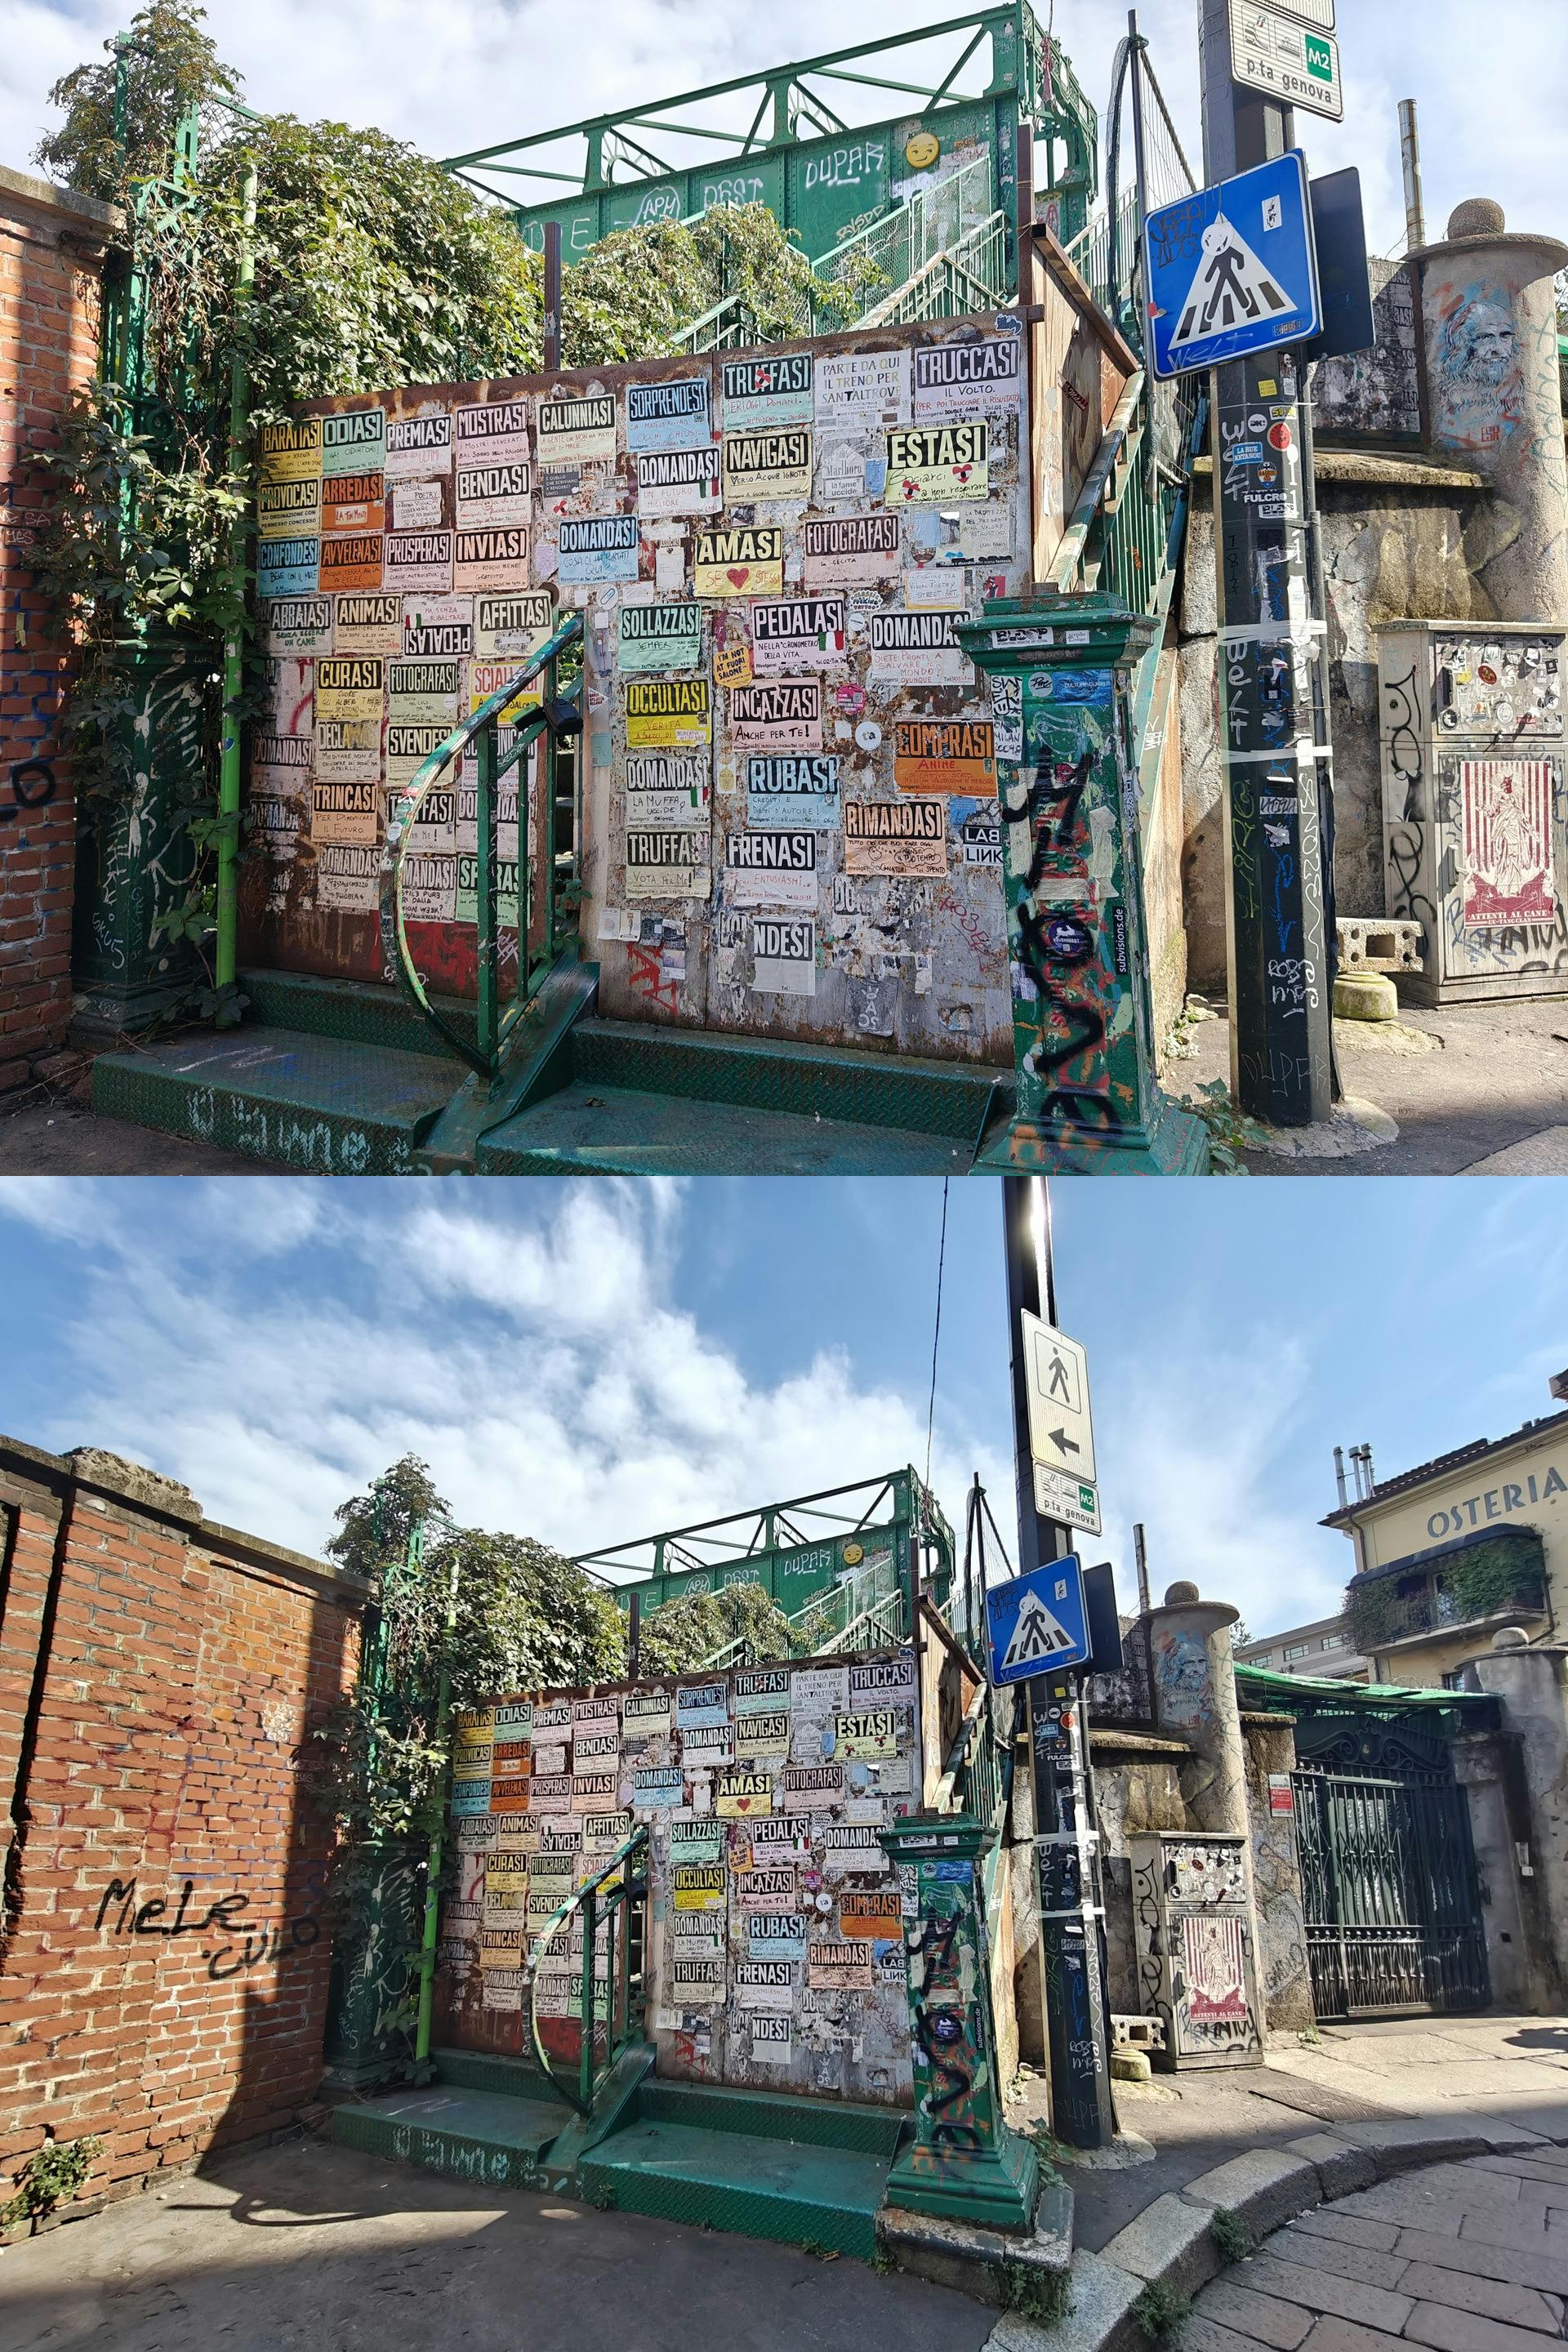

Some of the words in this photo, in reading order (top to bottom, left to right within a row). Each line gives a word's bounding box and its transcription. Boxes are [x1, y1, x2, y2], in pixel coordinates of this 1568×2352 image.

[1308, 47, 1330, 71] M2
[1246, 57, 1274, 81] p.ta
[1281, 74, 1332, 104] genova
[823, 362, 858, 376] PARTE
[861, 360, 877, 372] DA
[879, 357, 900, 369] QUI
[917, 341, 1018, 385] TRUCCASI
[824, 379, 834, 390] IL
[835, 374, 874, 388] TRENO
[877, 372, 900, 384] PER
[945, 388, 953, 398] IL
[960, 385, 996, 396] VOLTO.
[630, 384, 705, 420] SORPRENDESI
[949, 397, 981, 408] TRUCCARE
[457, 404, 527, 438] MOSTRASI
[541, 400, 612, 432] CALUNNIASI
[324, 413, 381, 446] ODIASI
[386, 419, 450, 450] PREMIASI
[492, 435, 523, 446] GENERATI
[547, 435, 565, 443] GENTE
[575, 433, 587, 442] NON
[505, 447, 528, 456] RAGIONE
[728, 434, 805, 471] NAVIGASI
[891, 426, 982, 470] ESTASI
[639, 451, 719, 486] DOMANDASI
[730, 474, 754, 485] VERSO
[825, 460, 862, 477] Marlboro
[323, 474, 384, 503] ARREDASI
[458, 466, 528, 500] BENDASI
[662, 487, 693, 496] FUTURO
[831, 488, 858, 497] uccide
[261, 481, 318, 511] PROVOCASI
[647, 499, 680, 508] MIGLIORE
[1243, 492, 1288, 504] FULCRO
[261, 521, 287, 529] PERMESSO
[287, 518, 317, 526] CONCESSO
[270, 511, 304, 520] ORDINAZIONE
[559, 516, 636, 552] DOMANDASI
[806, 517, 898, 555] FOTOGRAFASI
[260, 539, 318, 569] CONFONDESI
[322, 537, 381, 566] AVVELENASI
[387, 535, 449, 564] PROSPERASI
[457, 530, 525, 561] INVIASI
[697, 530, 782, 564] AMASI
[272, 601, 329, 629] ABBAIASI
[339, 598, 399, 626] ANIMASI
[482, 598, 549, 630] AFFITTASI
[621, 606, 701, 637] SOLLAZZASI
[755, 601, 844, 637] PEDALASI
[405, 626, 472, 655] PEDALASI
[872, 613, 969, 648] DOMANDAS
[635, 640, 672, 652] SEMPER
[731, 647, 745, 657] NOT
[758, 642, 781, 651] NELLA
[764, 652, 781, 660] DELLA
[319, 662, 378, 688] CURASI
[716, 664, 725, 672] AT
[726, 657, 746, 670] FUORI
[718, 667, 742, 680] SALONE
[877, 661, 921, 670] SALVARE
[390, 664, 457, 693] FOTOGRAFASI
[629, 680, 707, 715] OCCULTASI
[734, 686, 817, 720] INCAZZASI
[734, 724, 765, 742] ANCHE
[769, 729, 785, 739] PER
[898, 723, 992, 759] COMPRASI
[626, 756, 708, 791] DOMANDASI
[750, 758, 839, 793] RUBASI
[314, 784, 376, 811] TRINCASI
[632, 795, 644, 808] LA
[846, 803, 942, 837] RIMANDASI
[728, 835, 812, 868] FRENASI
[633, 871, 657, 885] VOTA
[925, 866, 946, 874] SPENTO
[1469, 911, 1508, 921] ATTENTI
[1510, 911, 1523, 919] AL
[1523, 909, 1549, 918] CANE
[1117, 907, 1126, 973] subvisions.de
[1080, 1492, 1095, 1508] M2
[1426, 1466, 1568, 1539] OSTERIA
[1065, 1508, 1096, 1526] genova
[795, 1674, 817, 1683] PARTE
[818, 1673, 829, 1682] DA
[829, 1671, 843, 1680] QUI
[804, 1682, 826, 1690] TRENO
[828, 1680, 842, 1688] PER
[852, 1664, 913, 1690] TRUCCASI
[626, 1696, 669, 1717] CALUNNIASI
[678, 1686, 725, 1708] SORPRENDESI
[495, 1704, 530, 1725] ODIASI
[533, 1707, 572, 1727] PREMIASI
[575, 1700, 617, 1722] MOSTRASI
[684, 1726, 733, 1748] DOMANDASI
[737, 1716, 786, 1741] NAVIGASI
[837, 1713, 892, 1739] ESTASI
[455, 1746, 491, 1764] PROVOCASI
[493, 1741, 530, 1759] ARREDASI
[575, 1738, 617, 1757] BENDASI
[492, 1779, 529, 1797] AVVELENASI
[532, 1777, 570, 1796] PROSPERASI
[573, 1775, 616, 1795] INVIASI
[635, 1768, 681, 1788] DOMANDASI
[719, 1775, 770, 1796] AMASI
[786, 1767, 842, 1790] FOTOGRAFASI
[460, 1819, 496, 1835] ABBAIASI
[500, 1815, 538, 1833] ANIMASI
[587, 1817, 629, 1837] AFFITTASI
[671, 1821, 720, 1842] SOLLAZZASI
[754, 1818, 808, 1842] PEDALASI
[488, 1855, 524, 1872] CURASI
[531, 1856, 572, 1875] FOTOGRAFASI
[675, 1868, 724, 1889] OCCULTASI
[741, 1871, 794, 1895] INCAZZASI
[841, 1893, 900, 1915] COMPRASI
[675, 1915, 725, 1936] DOMANDASI
[751, 1916, 806, 1938] RUBASI
[482, 1931, 521, 1948] TRINCASI
[810, 1944, 869, 1966] RIMANDASI
[737, 1962, 791, 1984] FRENASI
